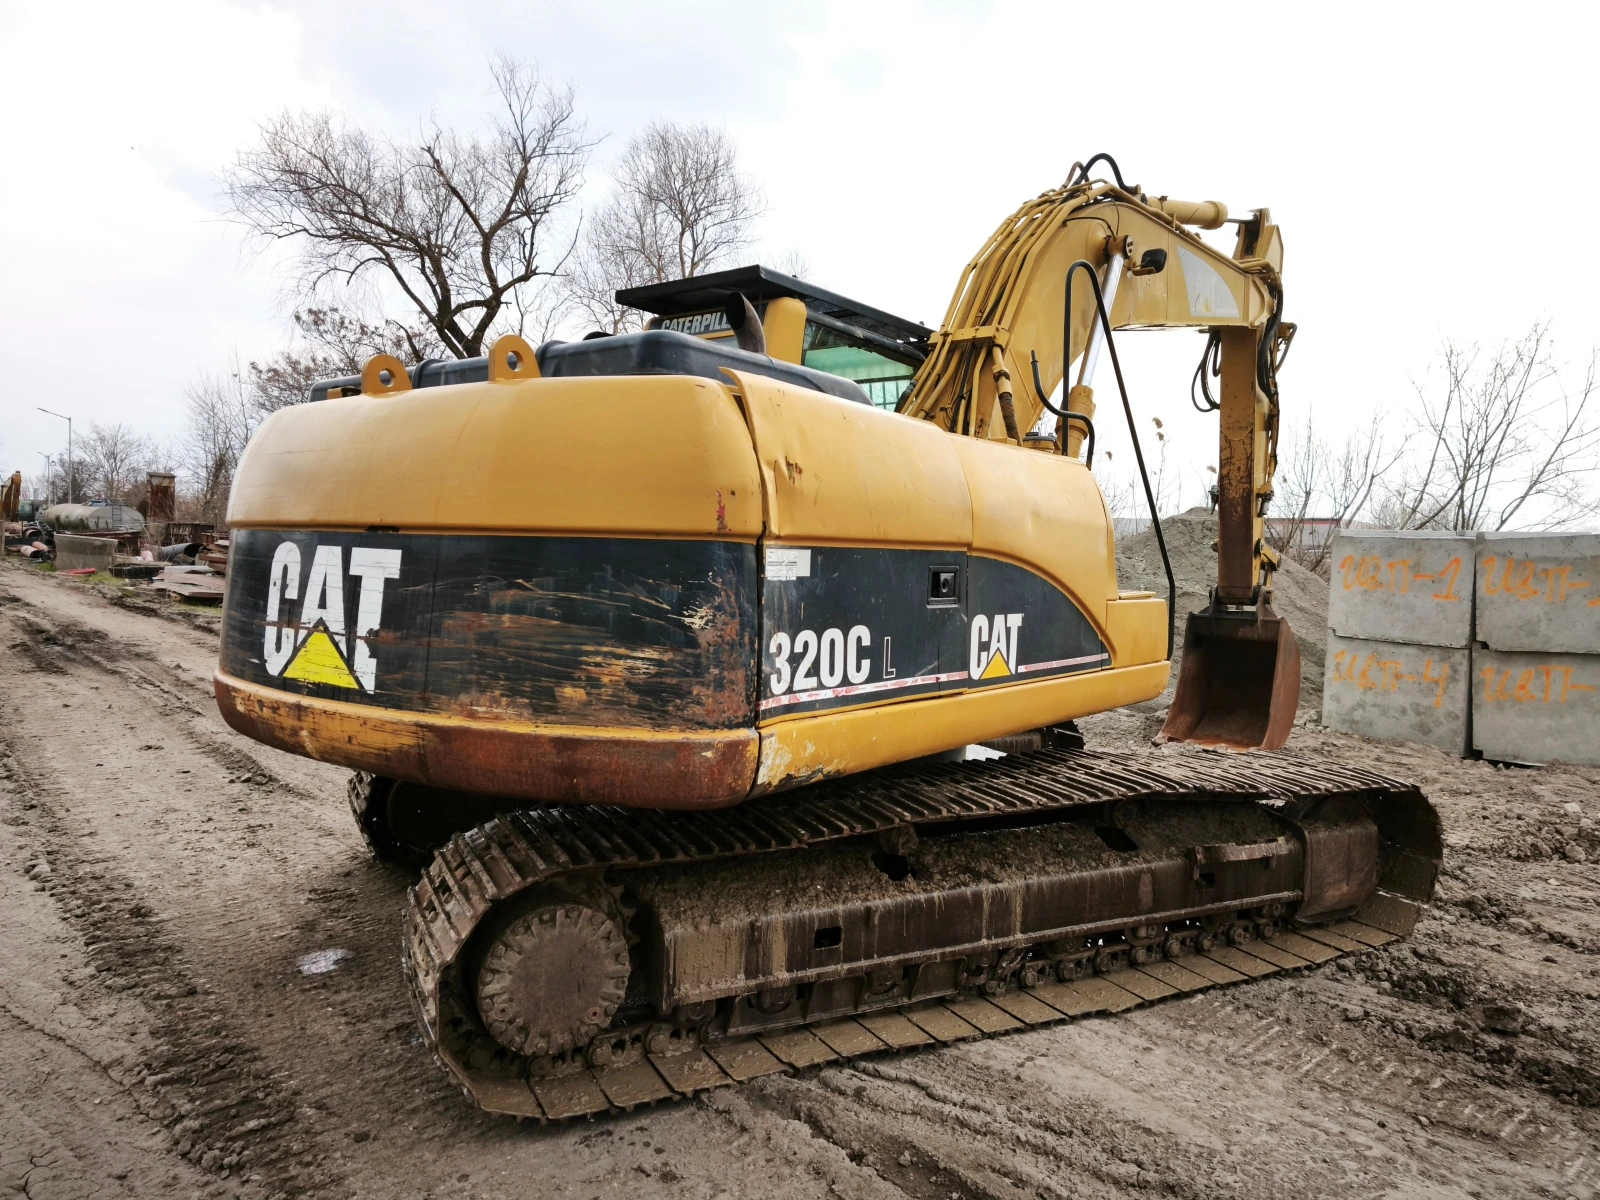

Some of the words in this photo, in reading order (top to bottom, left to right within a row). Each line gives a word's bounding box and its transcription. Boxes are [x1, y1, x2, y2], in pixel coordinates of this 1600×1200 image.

[660, 311, 732, 334] CATERPILL
[264, 542, 402, 694] CAT
[970, 613, 1023, 681] CAT
[769, 625, 871, 695] 320C
[883, 637, 896, 680] L
